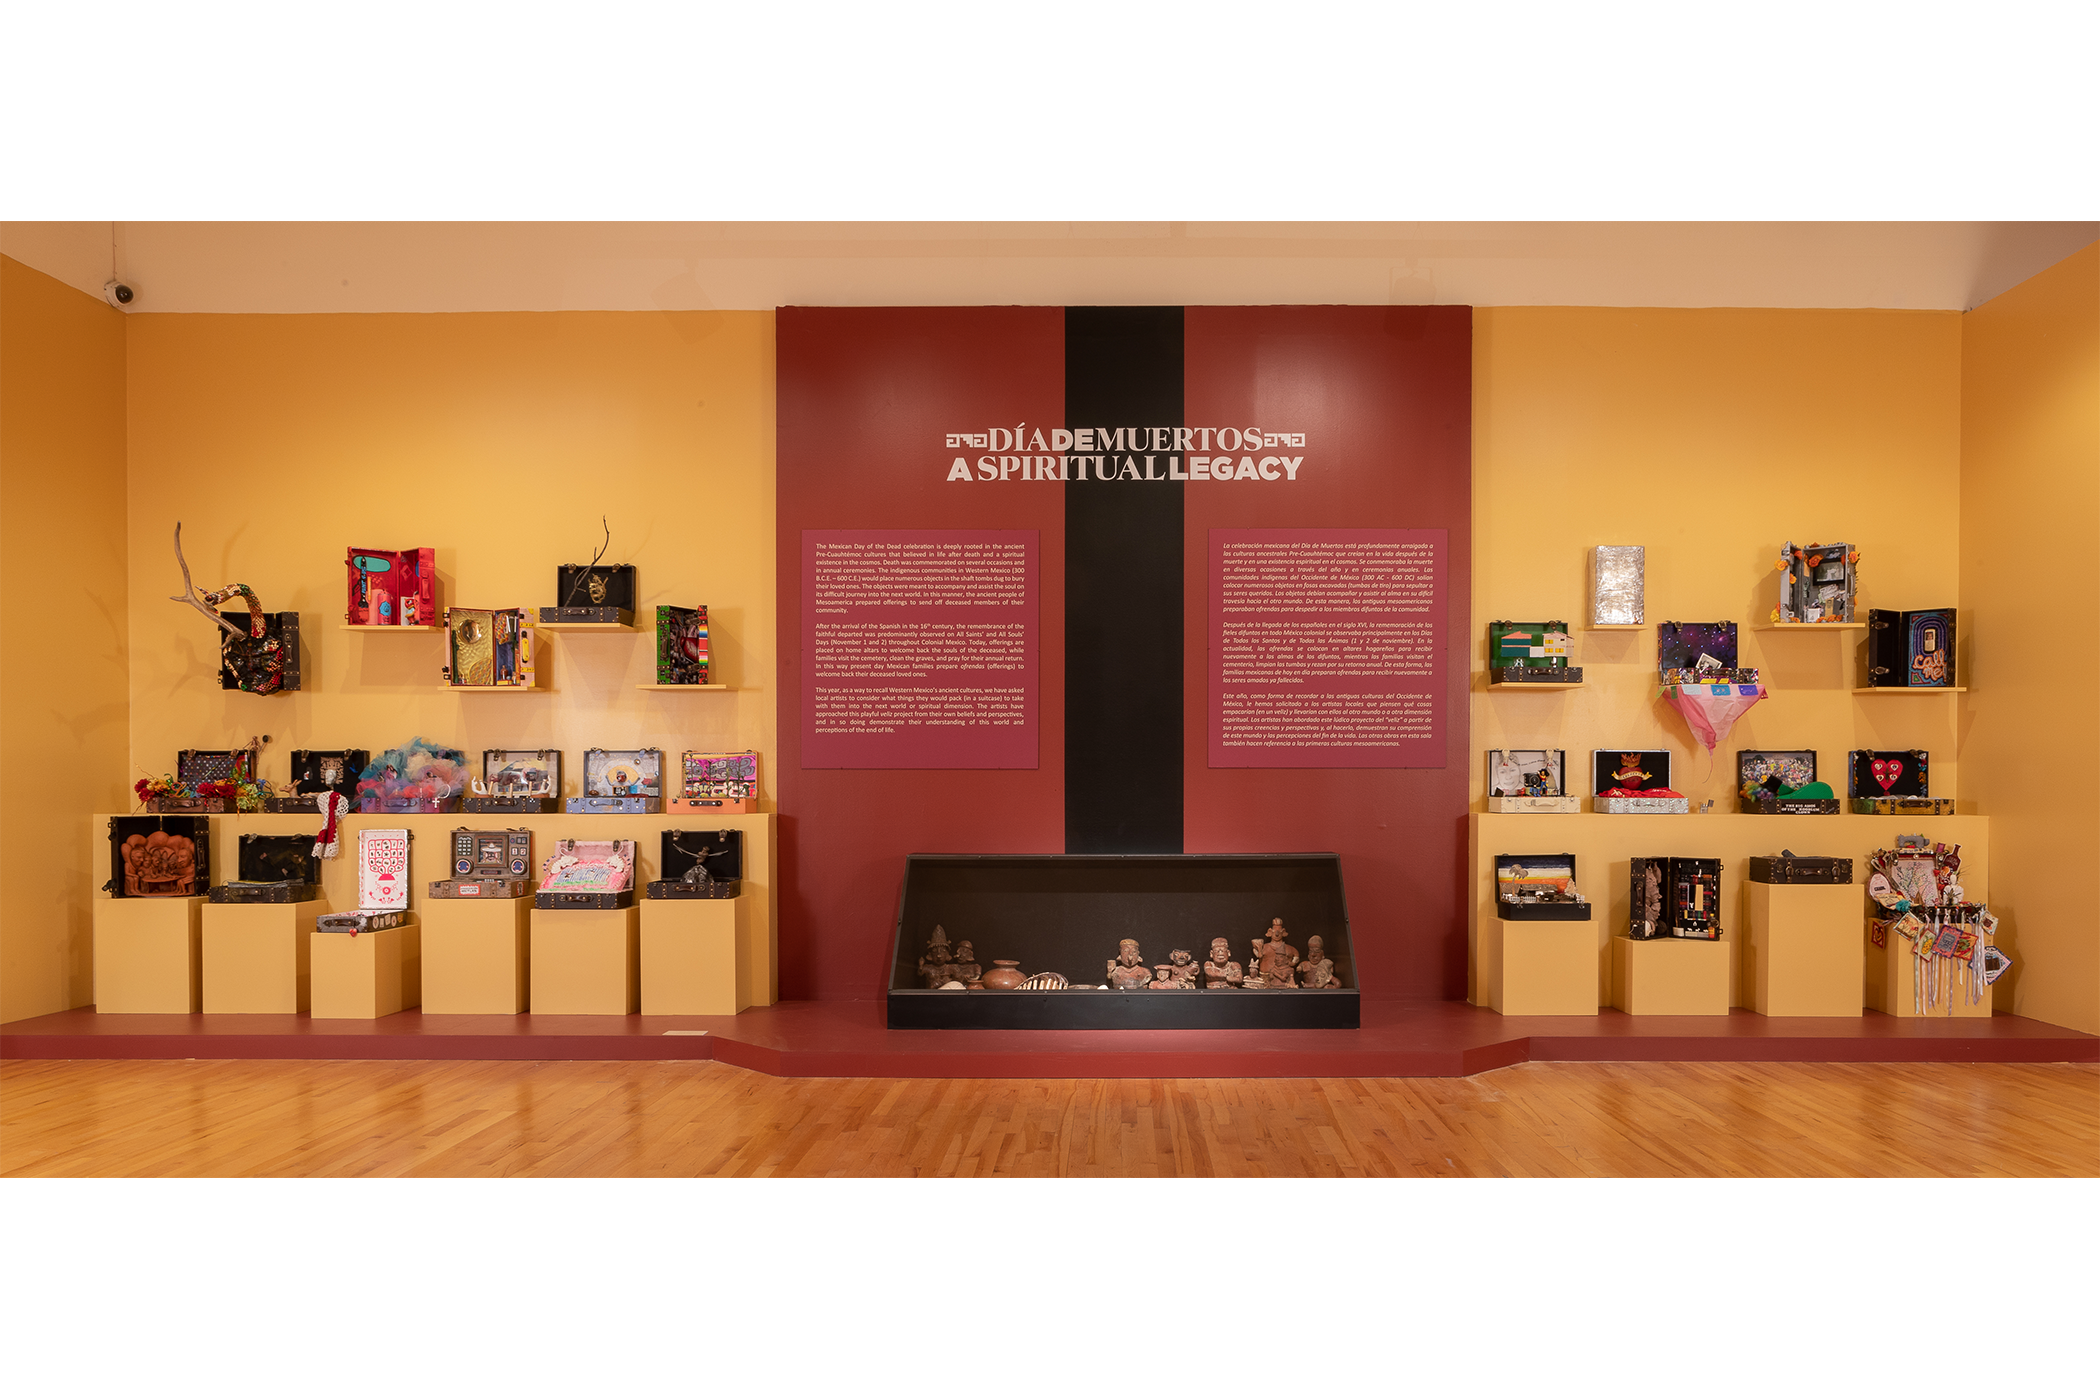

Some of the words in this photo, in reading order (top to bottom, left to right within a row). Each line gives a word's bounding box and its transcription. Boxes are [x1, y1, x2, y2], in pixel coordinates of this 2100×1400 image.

[946, 458, 974, 482] A
[977, 455, 1166, 481] SPIRITUAL
[1169, 456, 1304, 481] LEGACY
[960, 663, 984, 671] ofrendas
